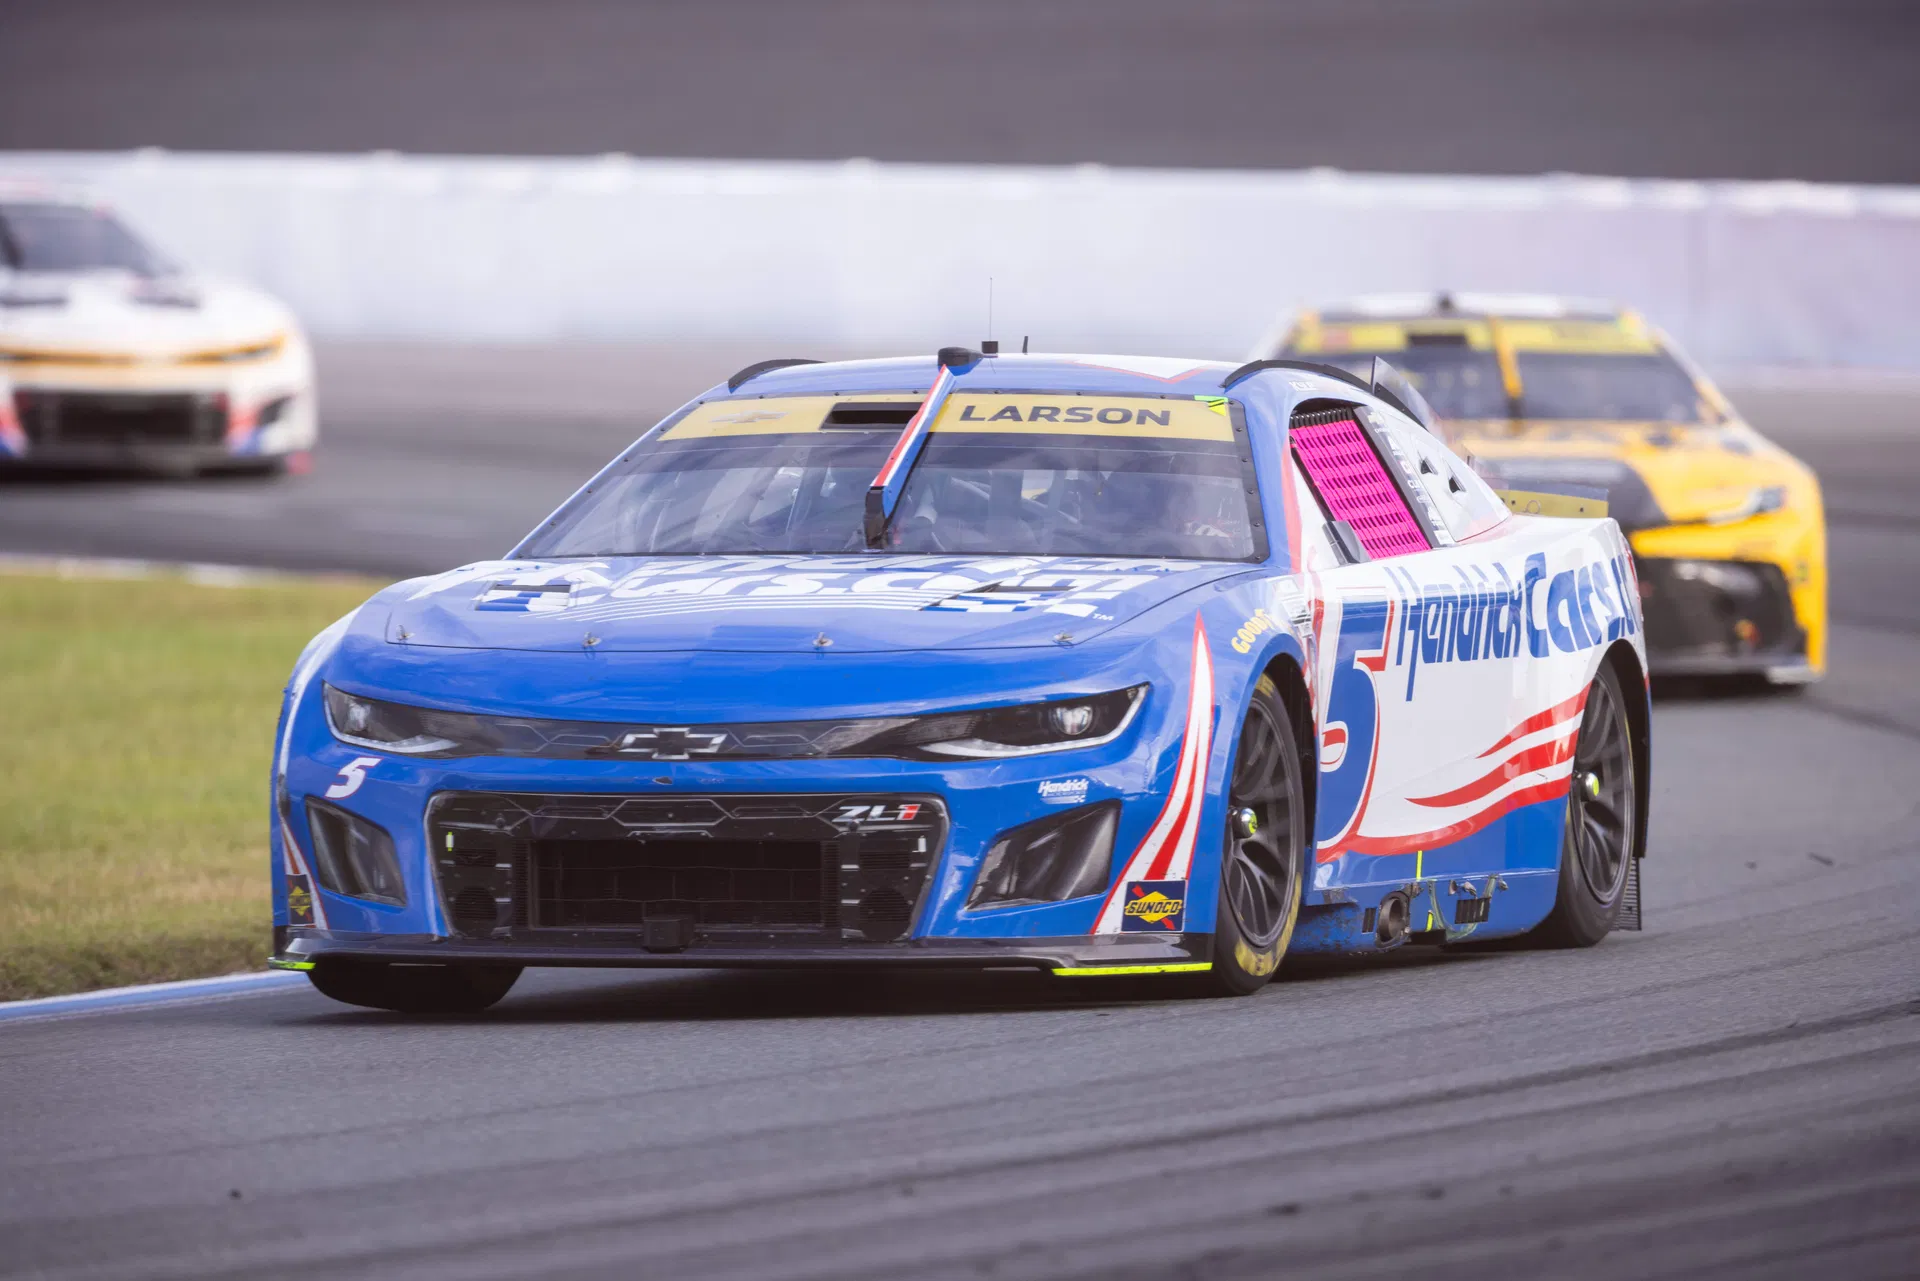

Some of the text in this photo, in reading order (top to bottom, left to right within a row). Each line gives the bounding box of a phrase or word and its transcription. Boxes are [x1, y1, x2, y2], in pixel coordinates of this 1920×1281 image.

[959, 405, 1171, 426] LARSON
[1316, 588, 1396, 850] 5
[324, 757, 383, 799] 5
[1037, 778, 1089, 797] Hendrick
[832, 803, 921, 822] ZL1
[1127, 900, 1181, 914] SUNOCO
